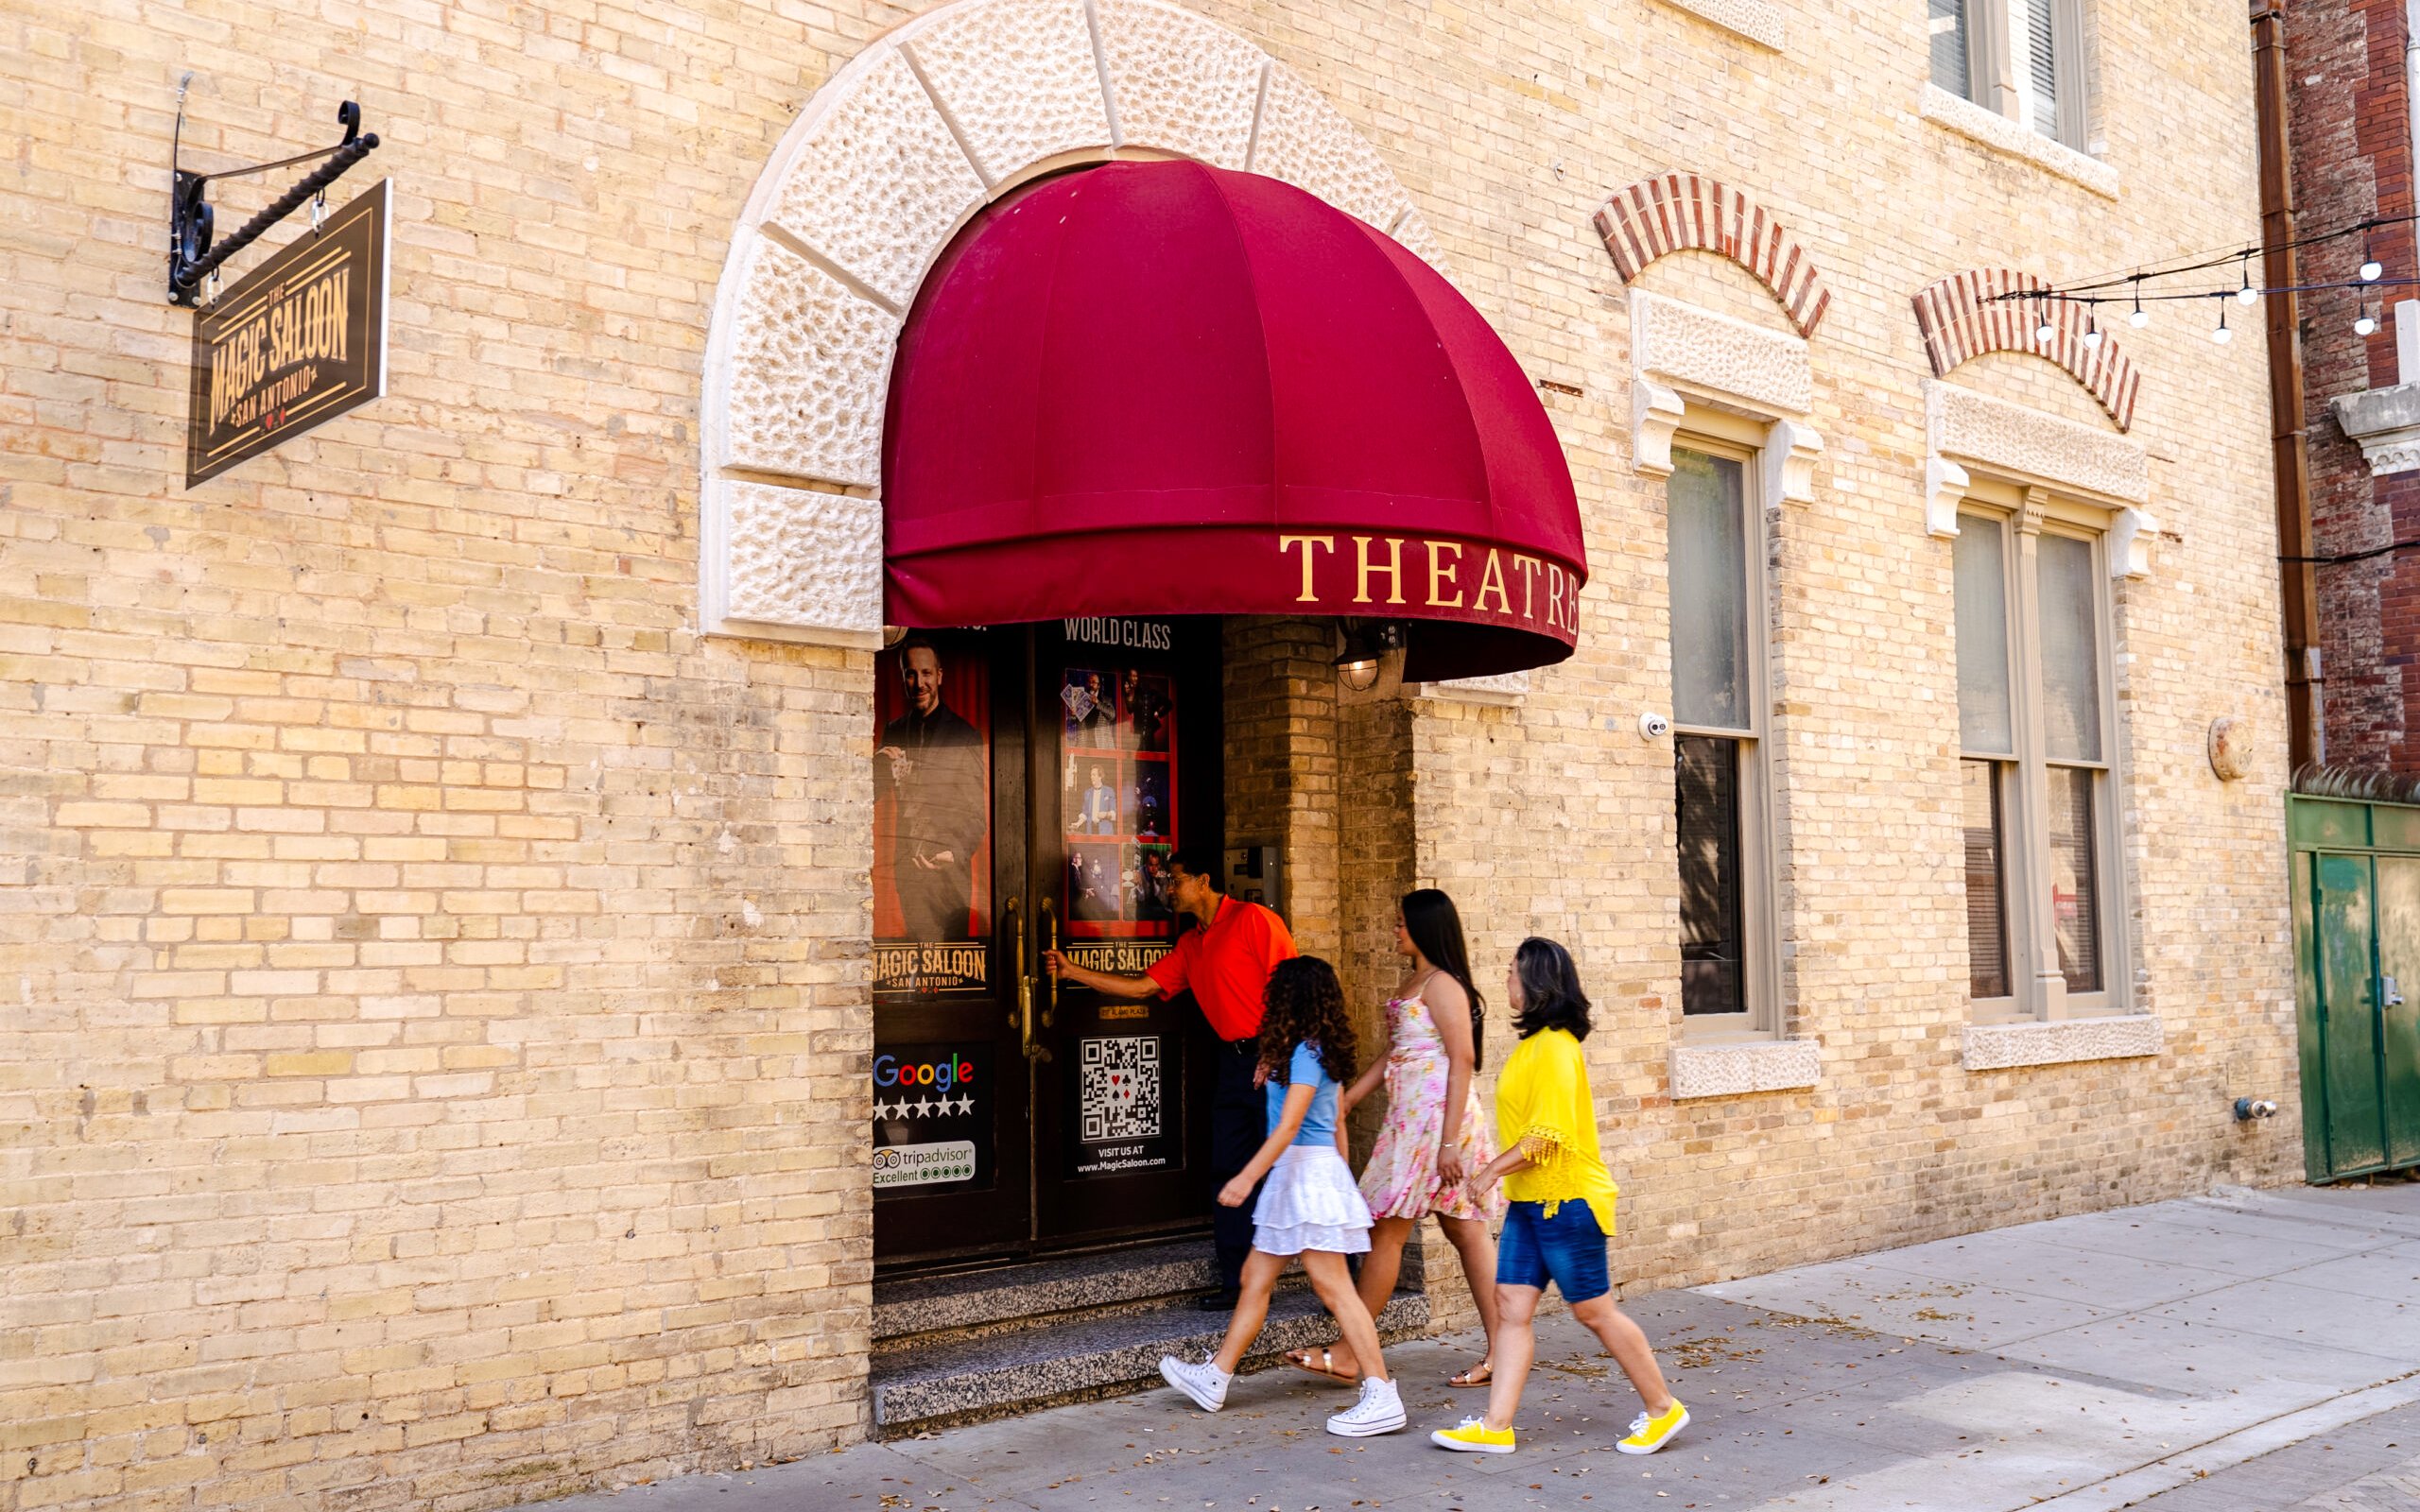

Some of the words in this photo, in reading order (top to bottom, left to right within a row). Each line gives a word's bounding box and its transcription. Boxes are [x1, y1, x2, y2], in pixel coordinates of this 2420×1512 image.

[268, 282, 285, 307] THE
[209, 316, 268, 437] MAGIC
[269, 266, 350, 372] SALOON
[235, 400, 256, 428] SAN
[260, 365, 310, 414] ANTONIO
[1279, 535, 1578, 636] THEATRE
[1064, 617, 1119, 644] WORLD
[1123, 620, 1171, 650] CLASS
[919, 941, 934, 950] THE
[922, 950, 986, 982] SALOON
[1116, 948, 1171, 971] SALOO
[891, 977, 911, 988] SAN
[914, 976, 959, 988] ANTONIO
[873, 1053, 974, 1092] Google
[1098, 1147, 1119, 1158] VISIT
[1120, 1146, 1132, 1156] US
[1132, 1145, 1144, 1155] AT
[873, 1169, 918, 1184] Excellent
[1078, 1158, 1166, 1172] www.MagicSaloon.com
